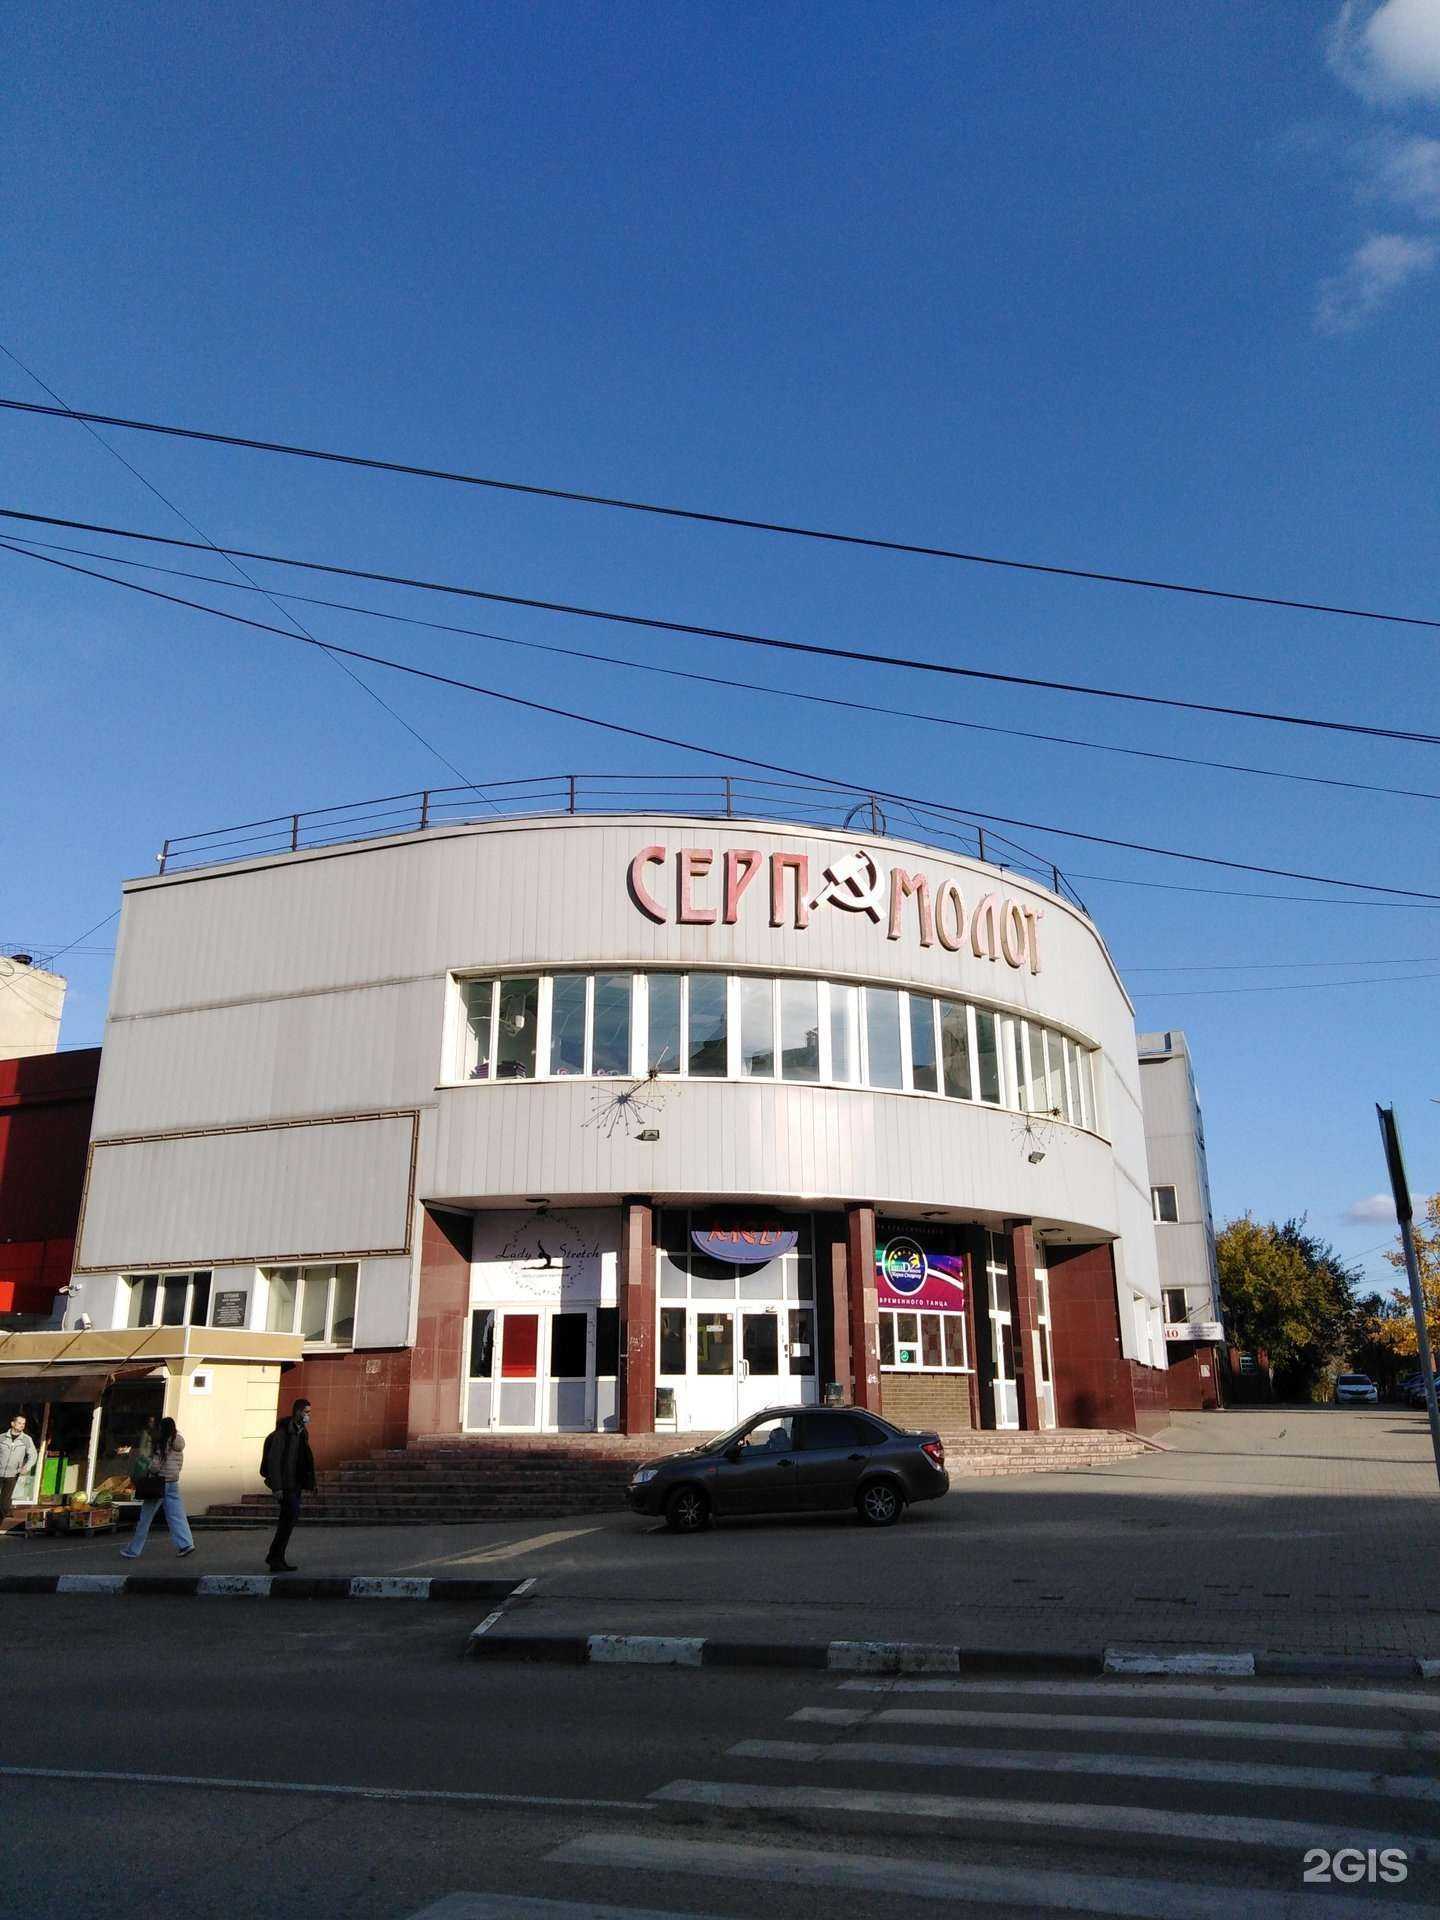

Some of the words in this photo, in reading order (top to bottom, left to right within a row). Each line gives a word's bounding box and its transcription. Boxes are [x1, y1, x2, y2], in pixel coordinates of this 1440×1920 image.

[627, 846, 808, 929] СЕРП
[887, 867, 1045, 975] МОЛОТ
[495, 1243, 532, 1260] Lady
[559, 1241, 600, 1258] Stretch
[879, 1297, 924, 1306] ВРЕМЕННОГО
[926, 1299, 948, 1307] ТАНЦА
